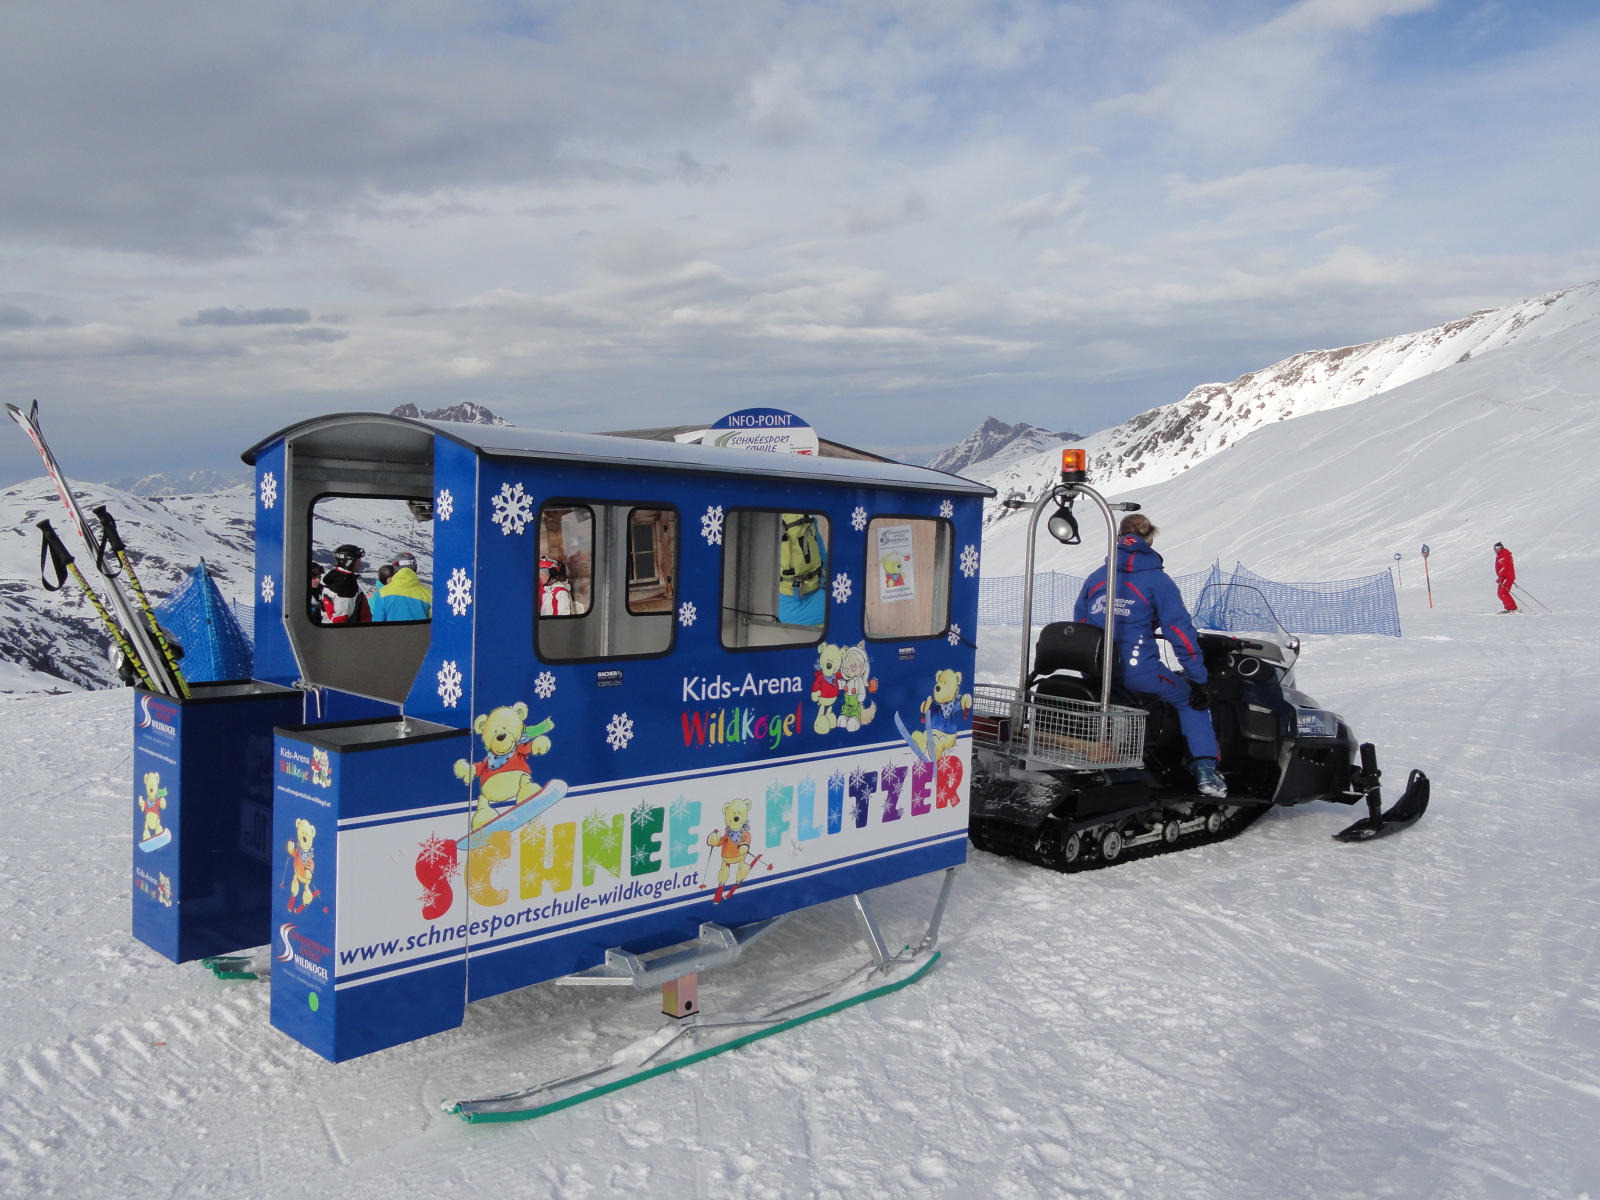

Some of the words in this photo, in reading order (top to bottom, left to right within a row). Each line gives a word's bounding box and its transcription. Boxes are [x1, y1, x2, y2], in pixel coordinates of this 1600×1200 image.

[728, 414, 793, 427] INFO-POINT
[682, 672, 803, 702] Kids-Arena
[681, 702, 803, 750] Wildkogel
[280, 746, 310, 765] Kids-Arena
[415, 798, 702, 921] SCHNEE
[765, 754, 962, 849] FLITZER
[339, 868, 700, 966] www.schneesportschule-wildkogel.at
[294, 953, 329, 980] WILDKOGEL
